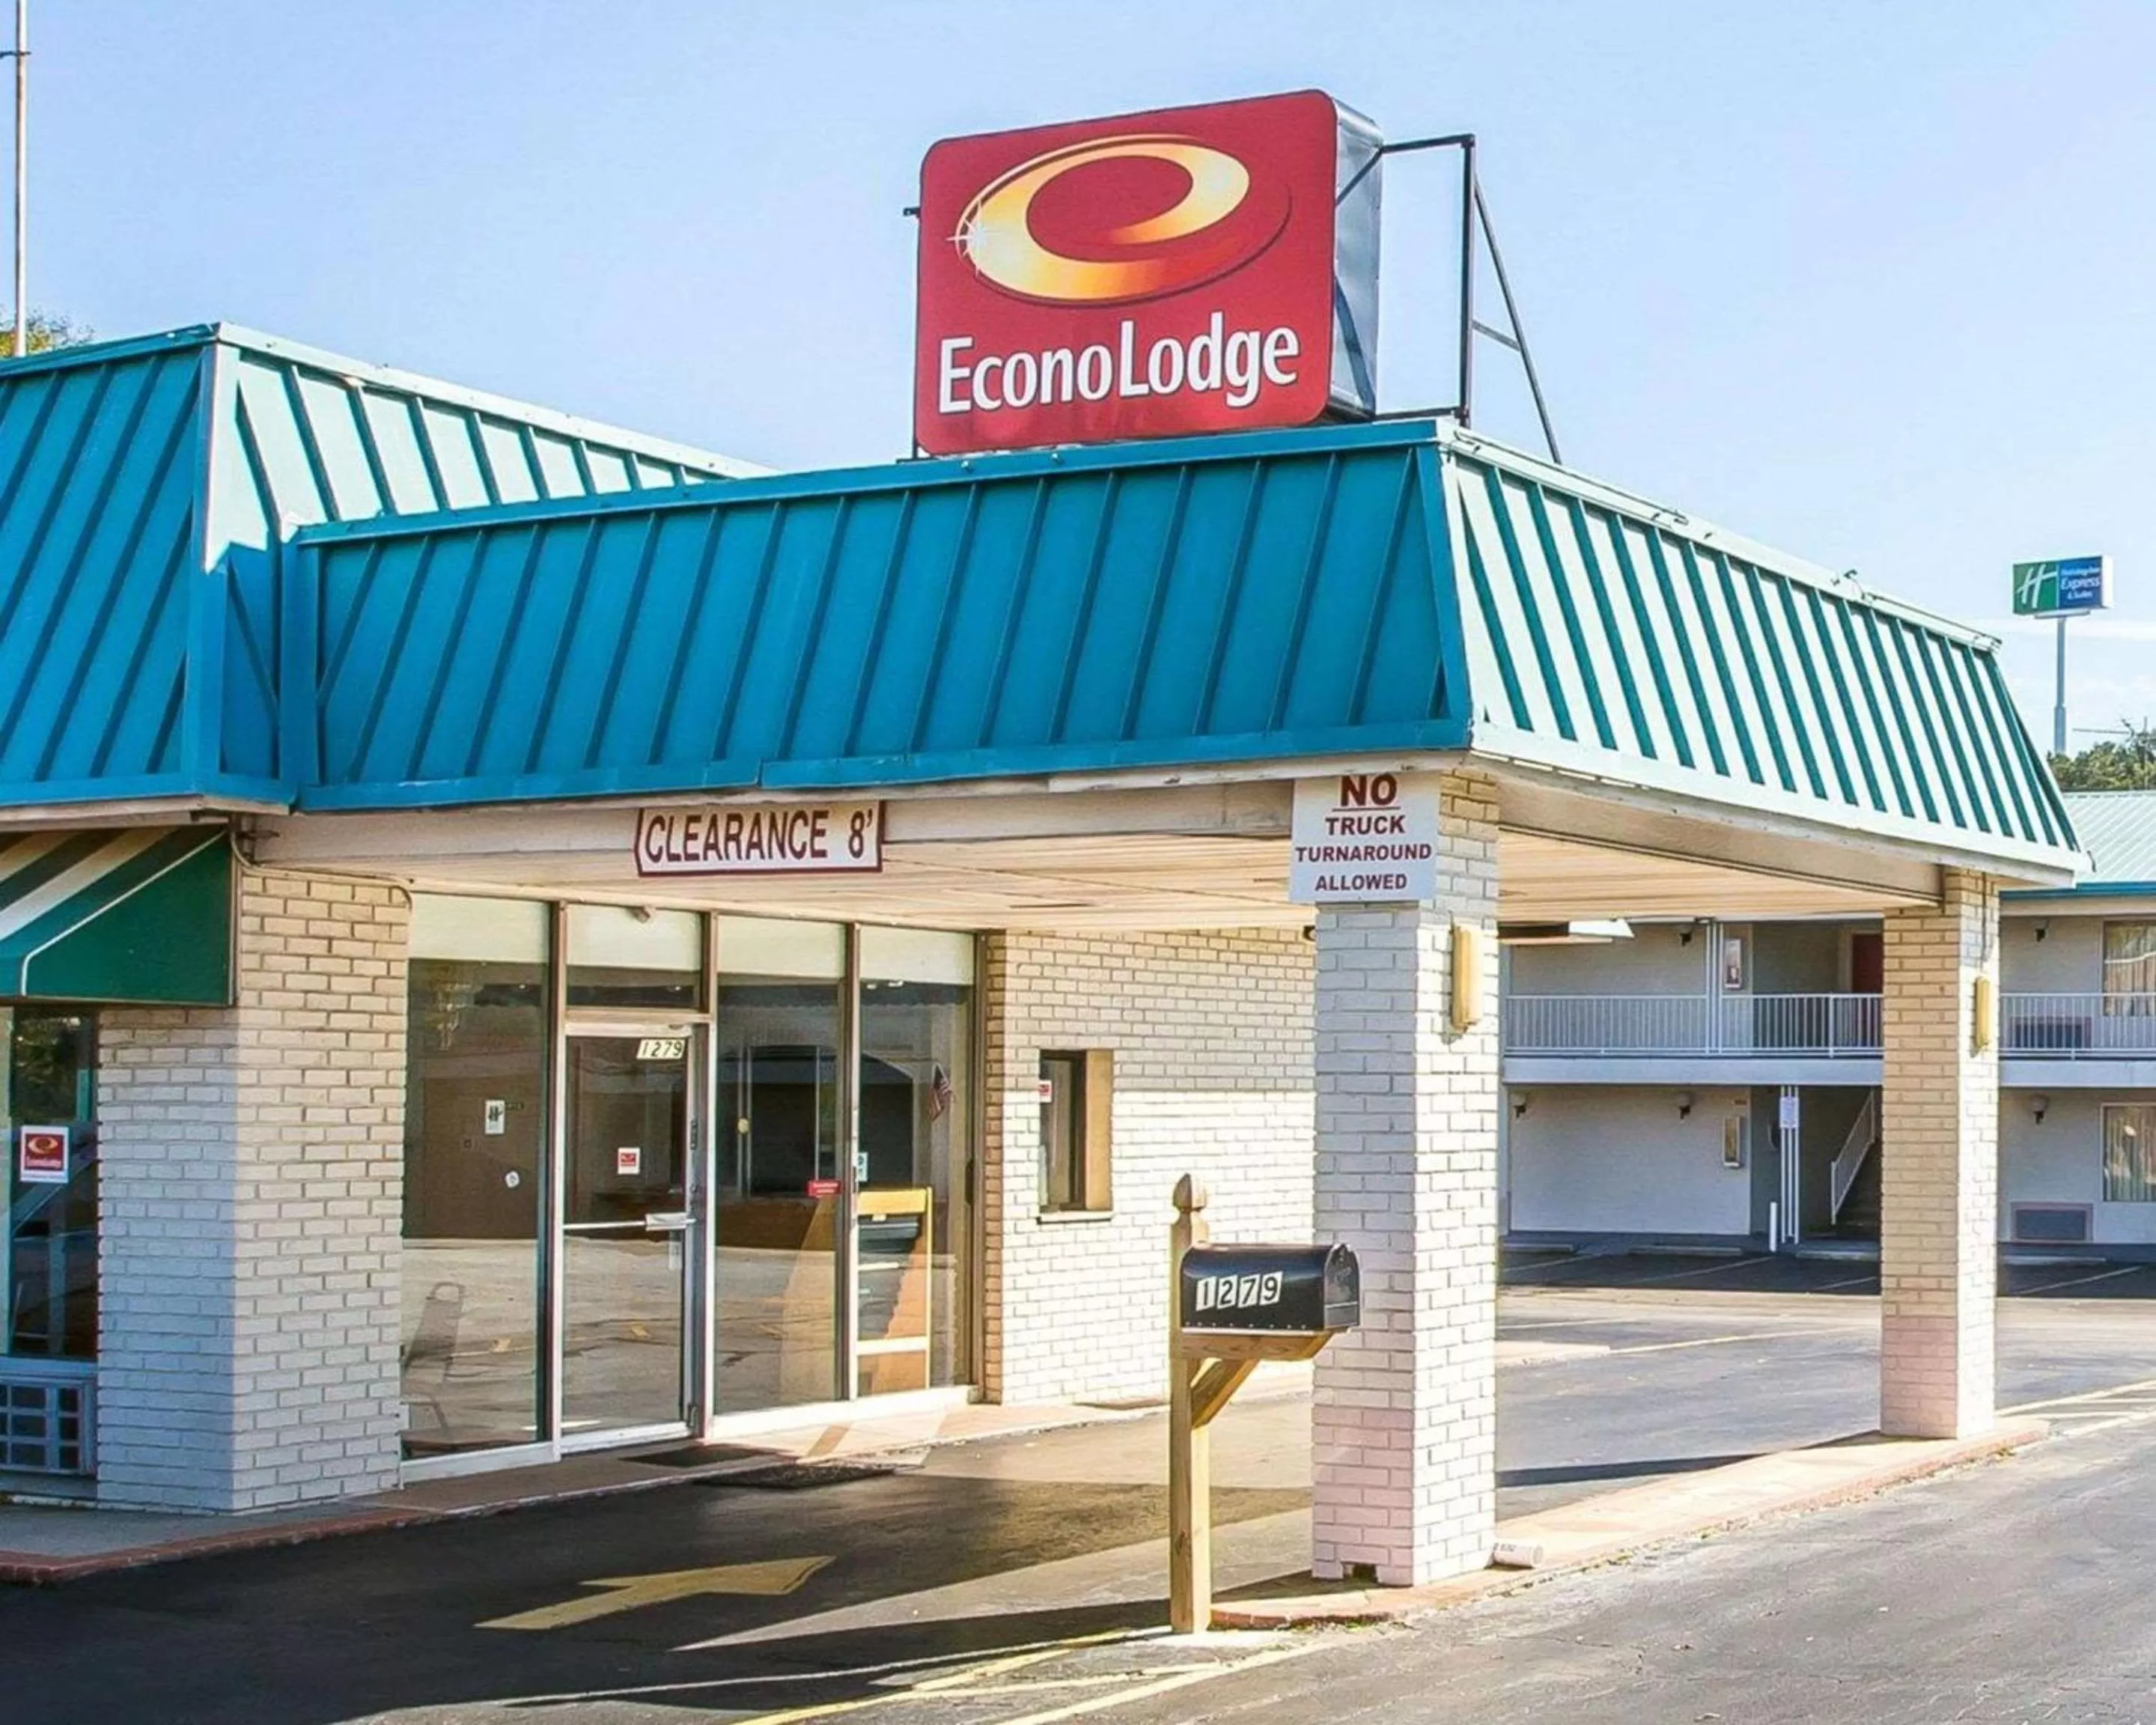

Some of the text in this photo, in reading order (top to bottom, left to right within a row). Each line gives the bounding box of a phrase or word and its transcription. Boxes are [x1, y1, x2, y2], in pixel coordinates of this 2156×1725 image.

[1340, 773, 1398, 807] NO
[645, 808, 873, 862] CLEARANCE 8'
[1325, 815, 1406, 836] TRUCK
[1294, 843, 1432, 862] TURNAROUND
[1315, 873, 1408, 892] ALLOWED
[642, 1041, 683, 1057] 1279
[1202, 1275, 1279, 1306] 1279
